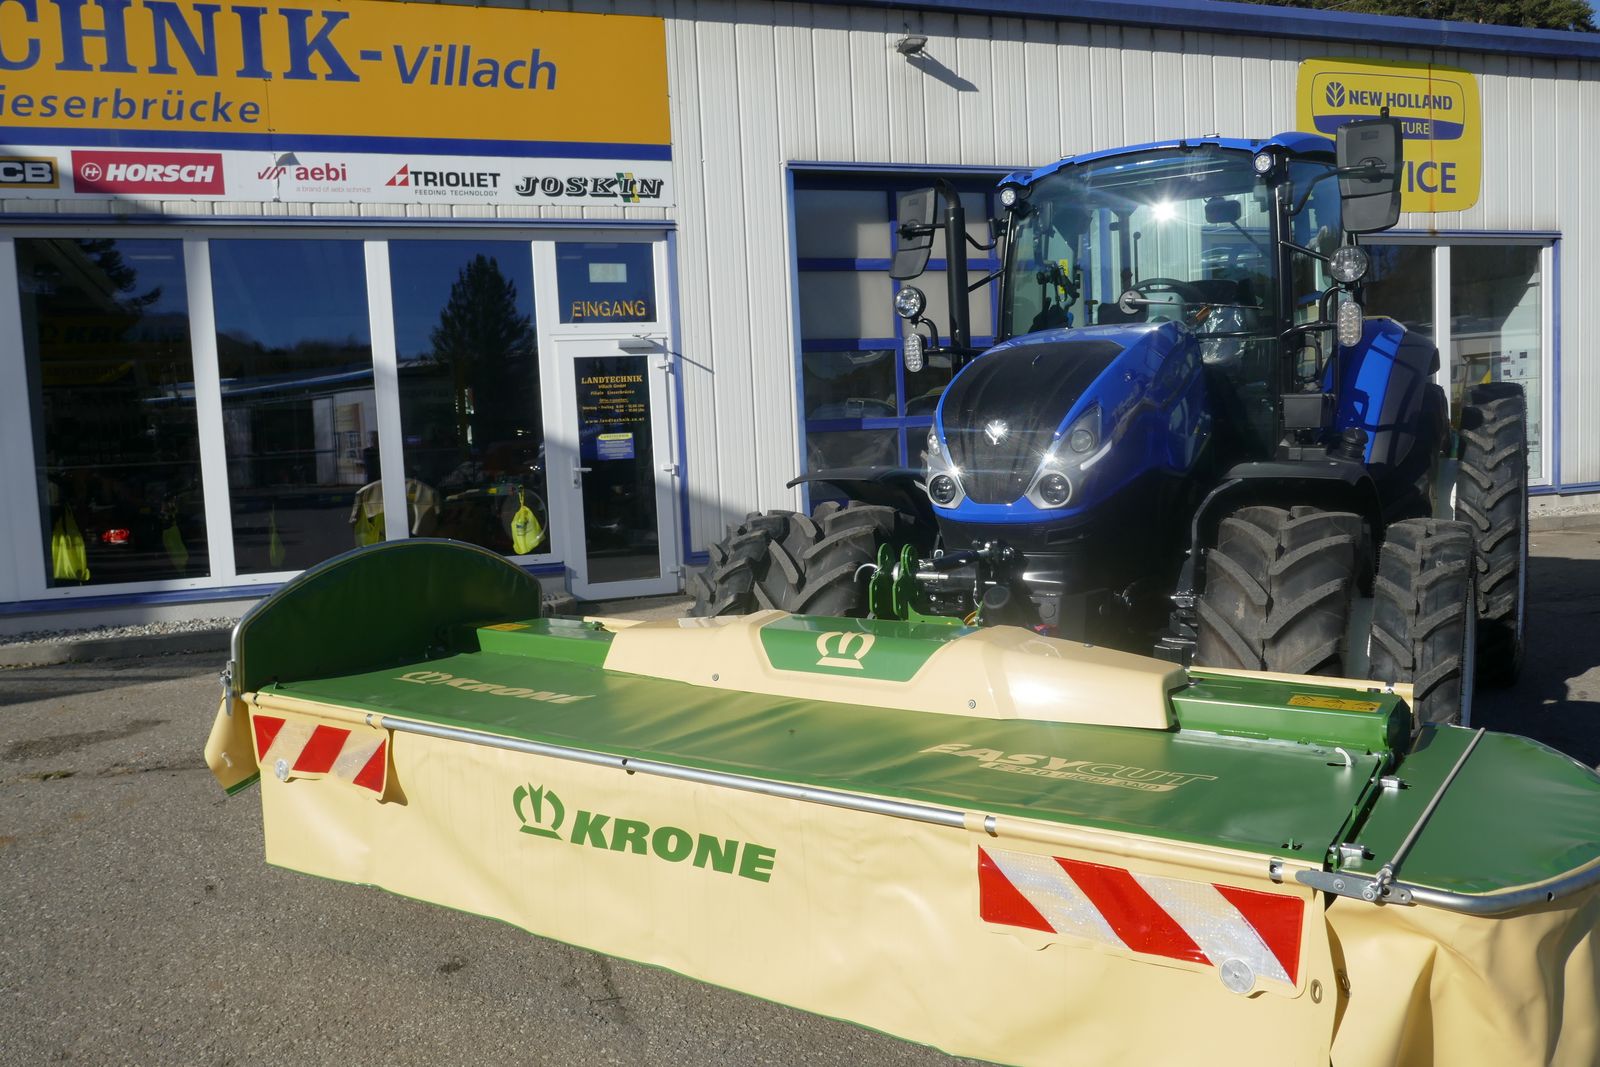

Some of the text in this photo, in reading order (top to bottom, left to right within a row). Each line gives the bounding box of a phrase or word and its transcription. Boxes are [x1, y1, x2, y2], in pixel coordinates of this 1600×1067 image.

[1348, 89, 1453, 111] NEW HOLLAND
[106, 163, 215, 184] HORSCH
[295, 163, 346, 181] aebi
[410, 171, 500, 188] TRIOLIET
[515, 174, 665, 199] JOSKIN
[572, 300, 646, 317] EINGANG
[581, 375, 643, 385] LANDTECHNIK
[570, 809, 777, 884] KRONE
